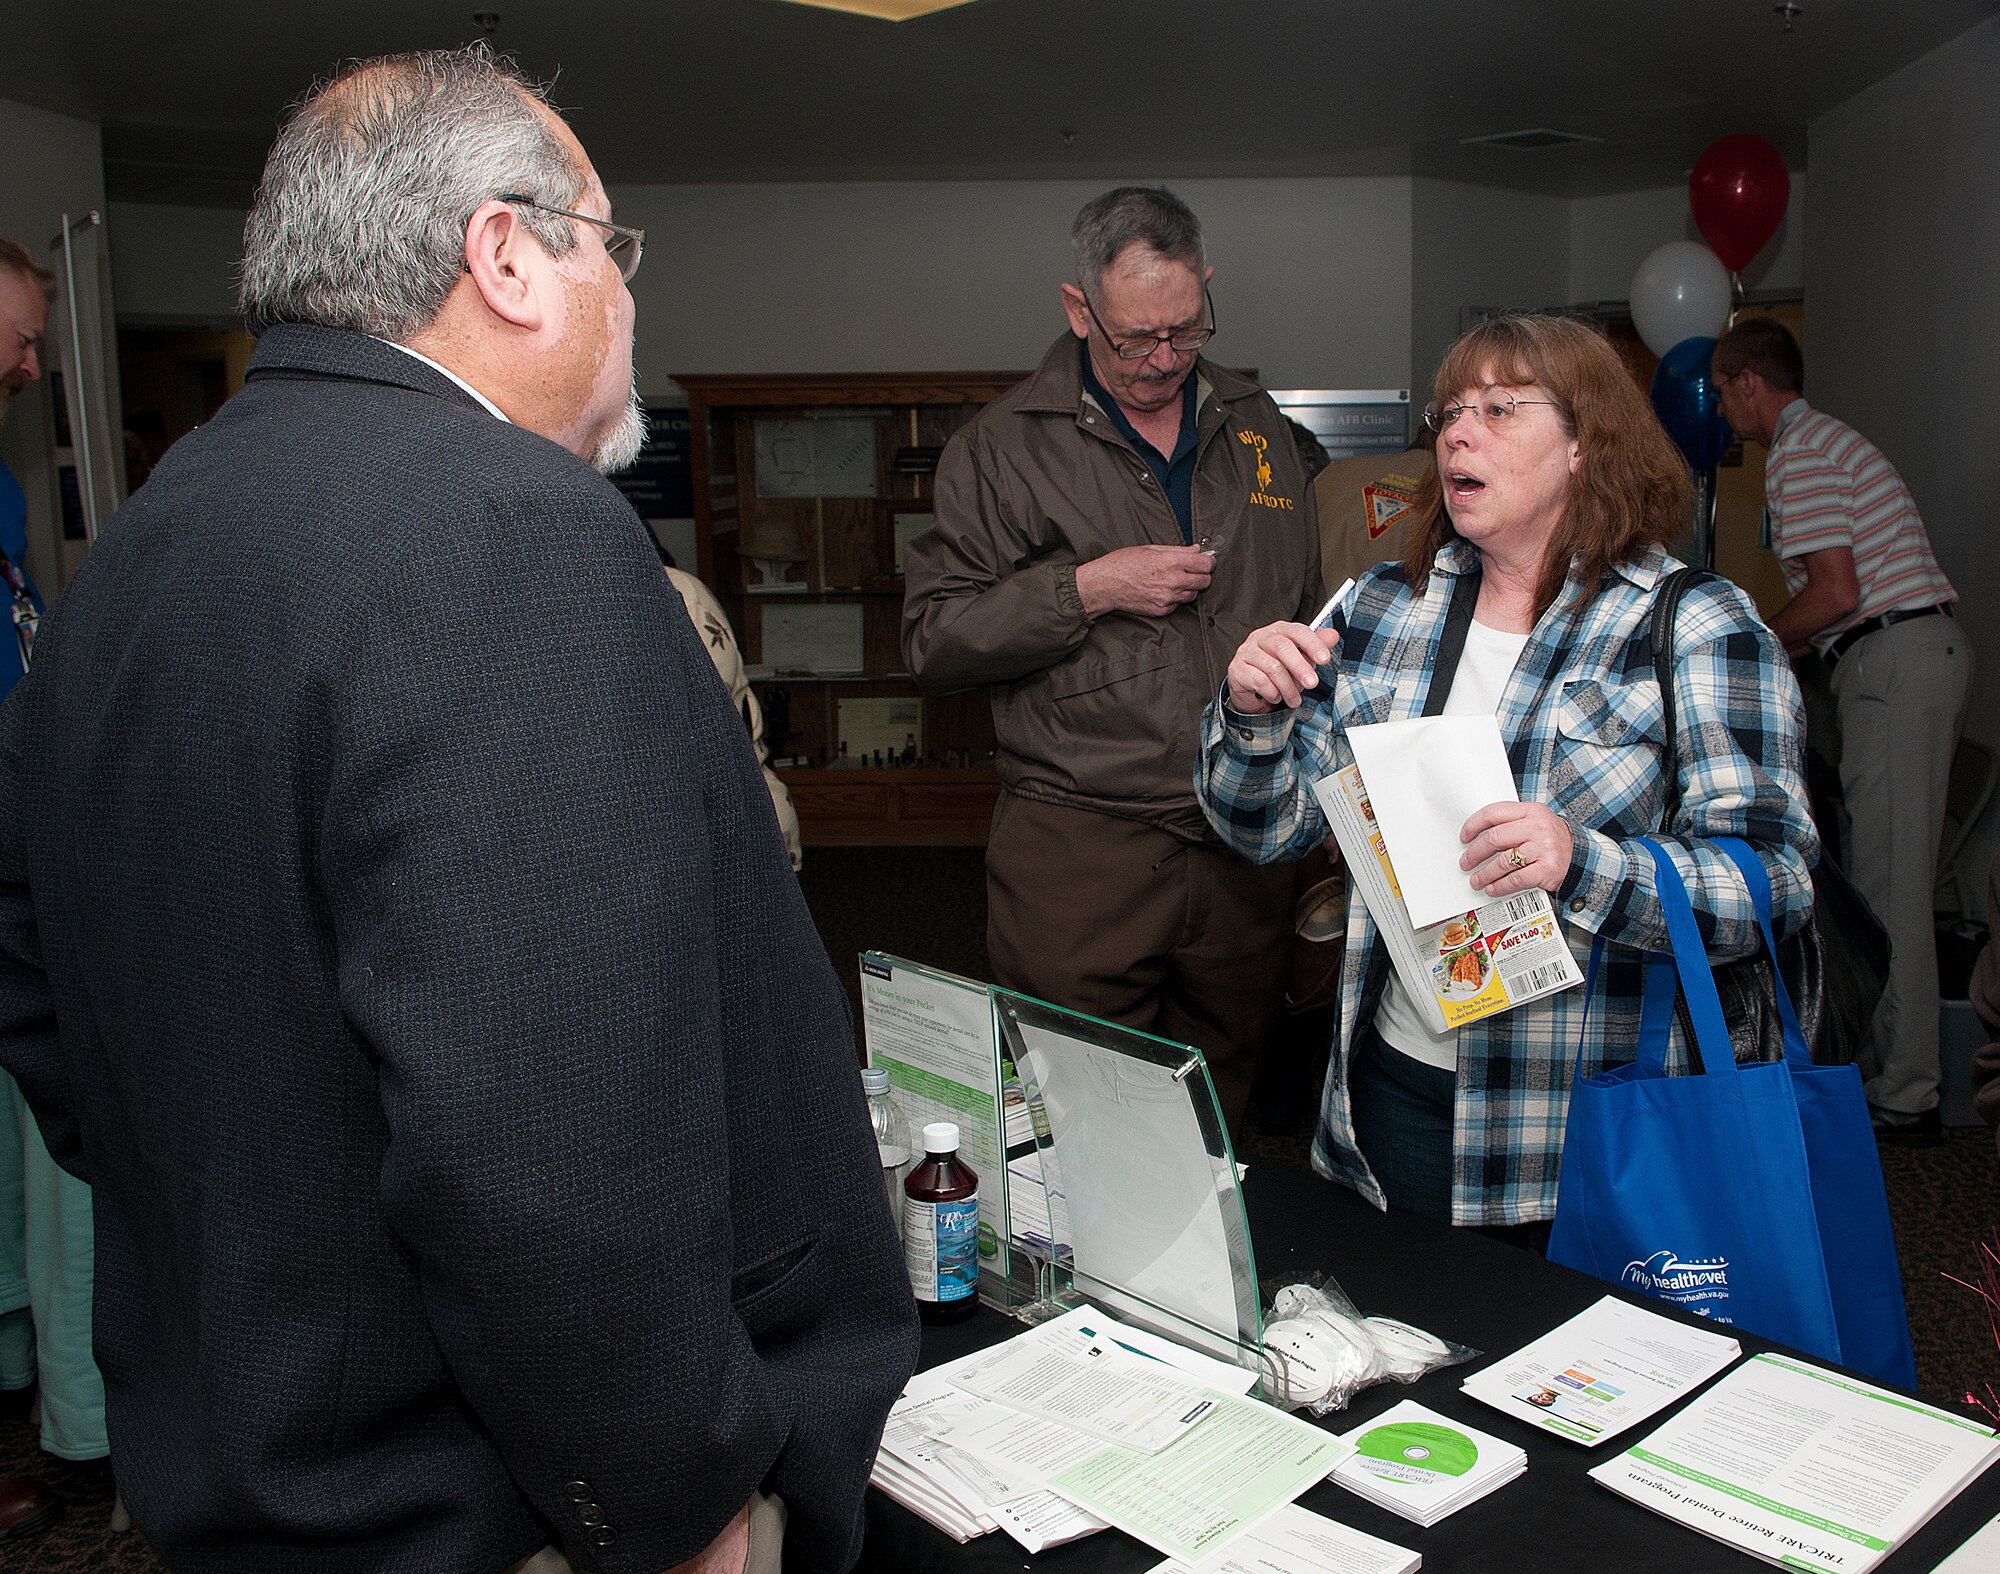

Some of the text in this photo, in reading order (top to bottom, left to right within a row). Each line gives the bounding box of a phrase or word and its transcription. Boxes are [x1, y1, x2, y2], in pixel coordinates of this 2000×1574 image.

[1338, 414, 1360, 425] AFB
[1362, 414, 1394, 425] Clinic
[1250, 491, 1294, 511] AFROTC
[1490, 935, 1502, 952] NEW!
[1501, 936, 1521, 951] SAVE
[1520, 926, 1540, 942] $1.00
[916, 998, 935, 1012] Pocket
[1630, 1267, 1652, 1290] My
[1289, 1353, 1301, 1363] Dental
[1301, 1360, 1317, 1372] Program
[931, 1391, 955, 1402] Program
[1368, 1458, 1436, 1478] Dental Program
[1627, 1472, 1845, 1566] TRICARE Retiree Dental Program
[1825, 1525, 1850, 1541] Sheet:
[1850, 1533, 1867, 1544] Fact
